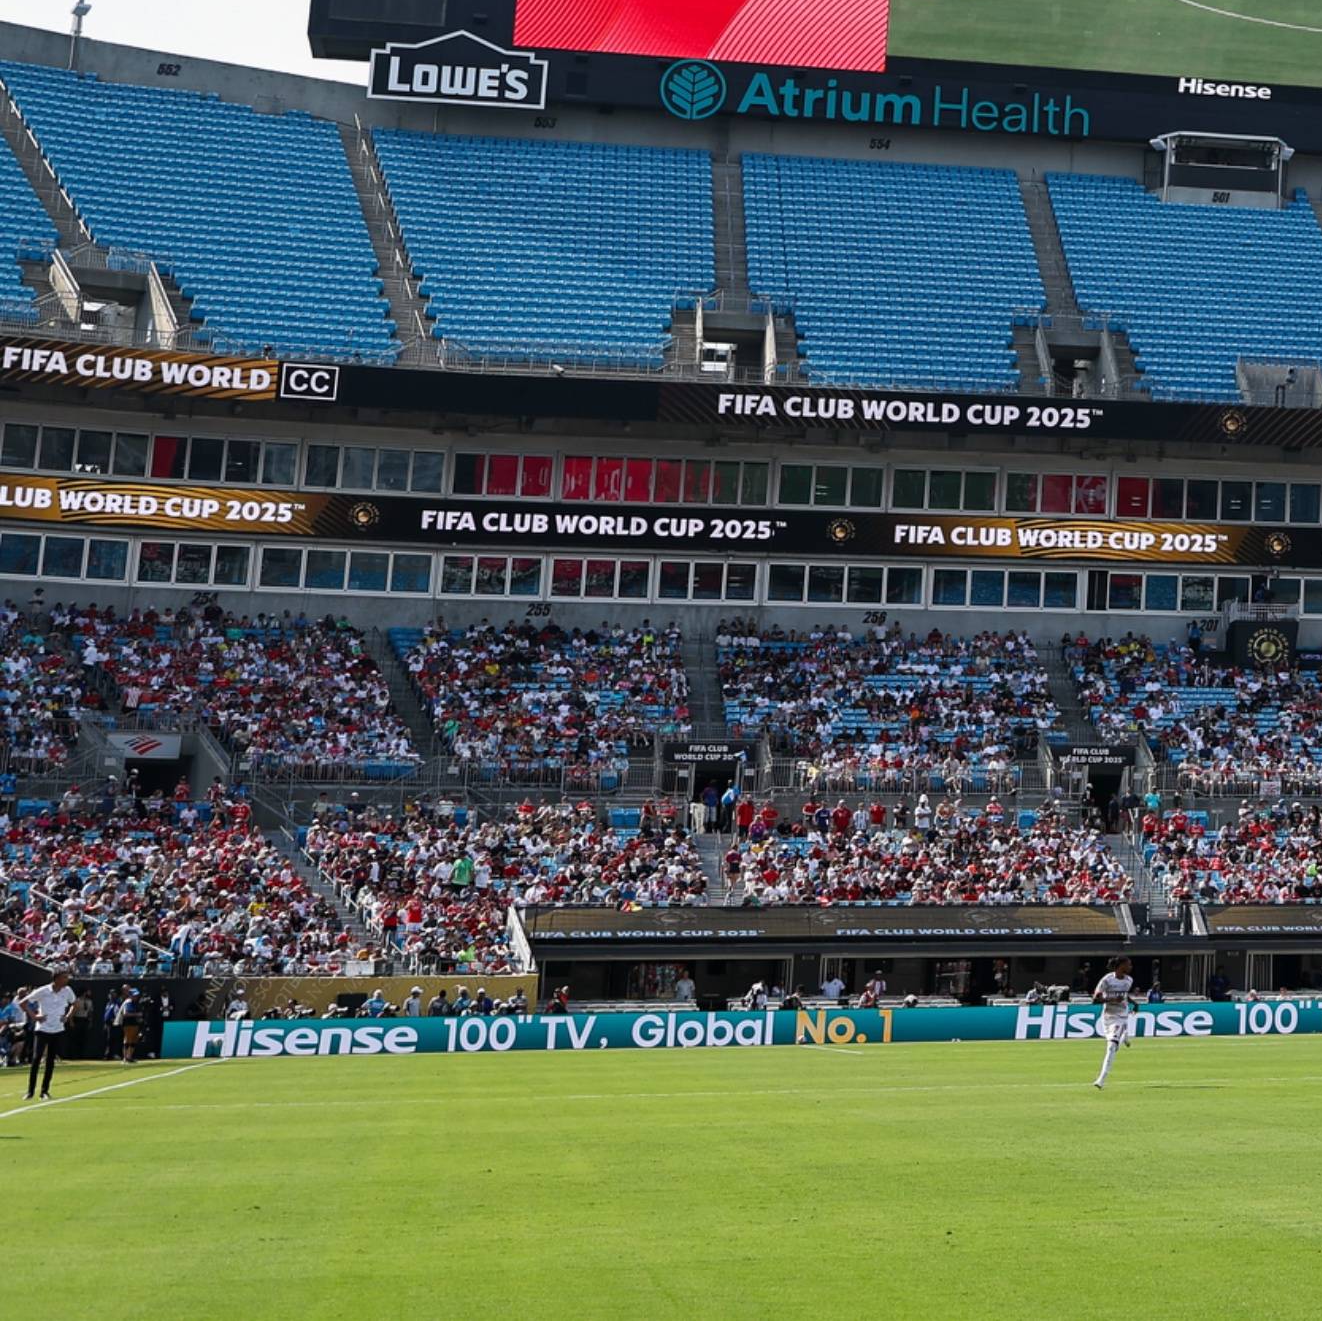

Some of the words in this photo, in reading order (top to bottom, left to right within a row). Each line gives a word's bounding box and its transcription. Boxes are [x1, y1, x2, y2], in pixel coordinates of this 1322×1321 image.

[1178, 77, 1272, 99] Hisense
[736, 73, 921, 125] Atrium
[933, 86, 1090, 136] Health
[3, 347, 68, 374] FIFA
[76, 355, 152, 381] CLUB
[161, 362, 271, 391] WORLD
[289, 370, 329, 394] CC
[718, 394, 776, 416] FIFA
[783, 395, 854, 420] CLUB
[862, 400, 960, 423] WORLD
[967, 404, 1019, 425] CUP
[58, 490, 158, 517] WORLD
[165, 498, 219, 518] CUP
[420, 510, 473, 530] FIFA
[482, 513, 548, 533] CLUB
[555, 515, 648, 537] WORLD
[653, 518, 703, 538] CUP
[894, 524, 945, 545] FIFA
[951, 526, 1011, 546] CLUB
[1017, 528, 1102, 549] WORLD
[1108, 532, 1154, 550] CUP
[526, 603, 552, 616] 255
[862, 611, 887, 623] 256
[192, 1020, 418, 1058] Hisense
[632, 1012, 774, 1048] Global
[796, 1010, 866, 1045] No.
[879, 1010, 892, 1042] 1
